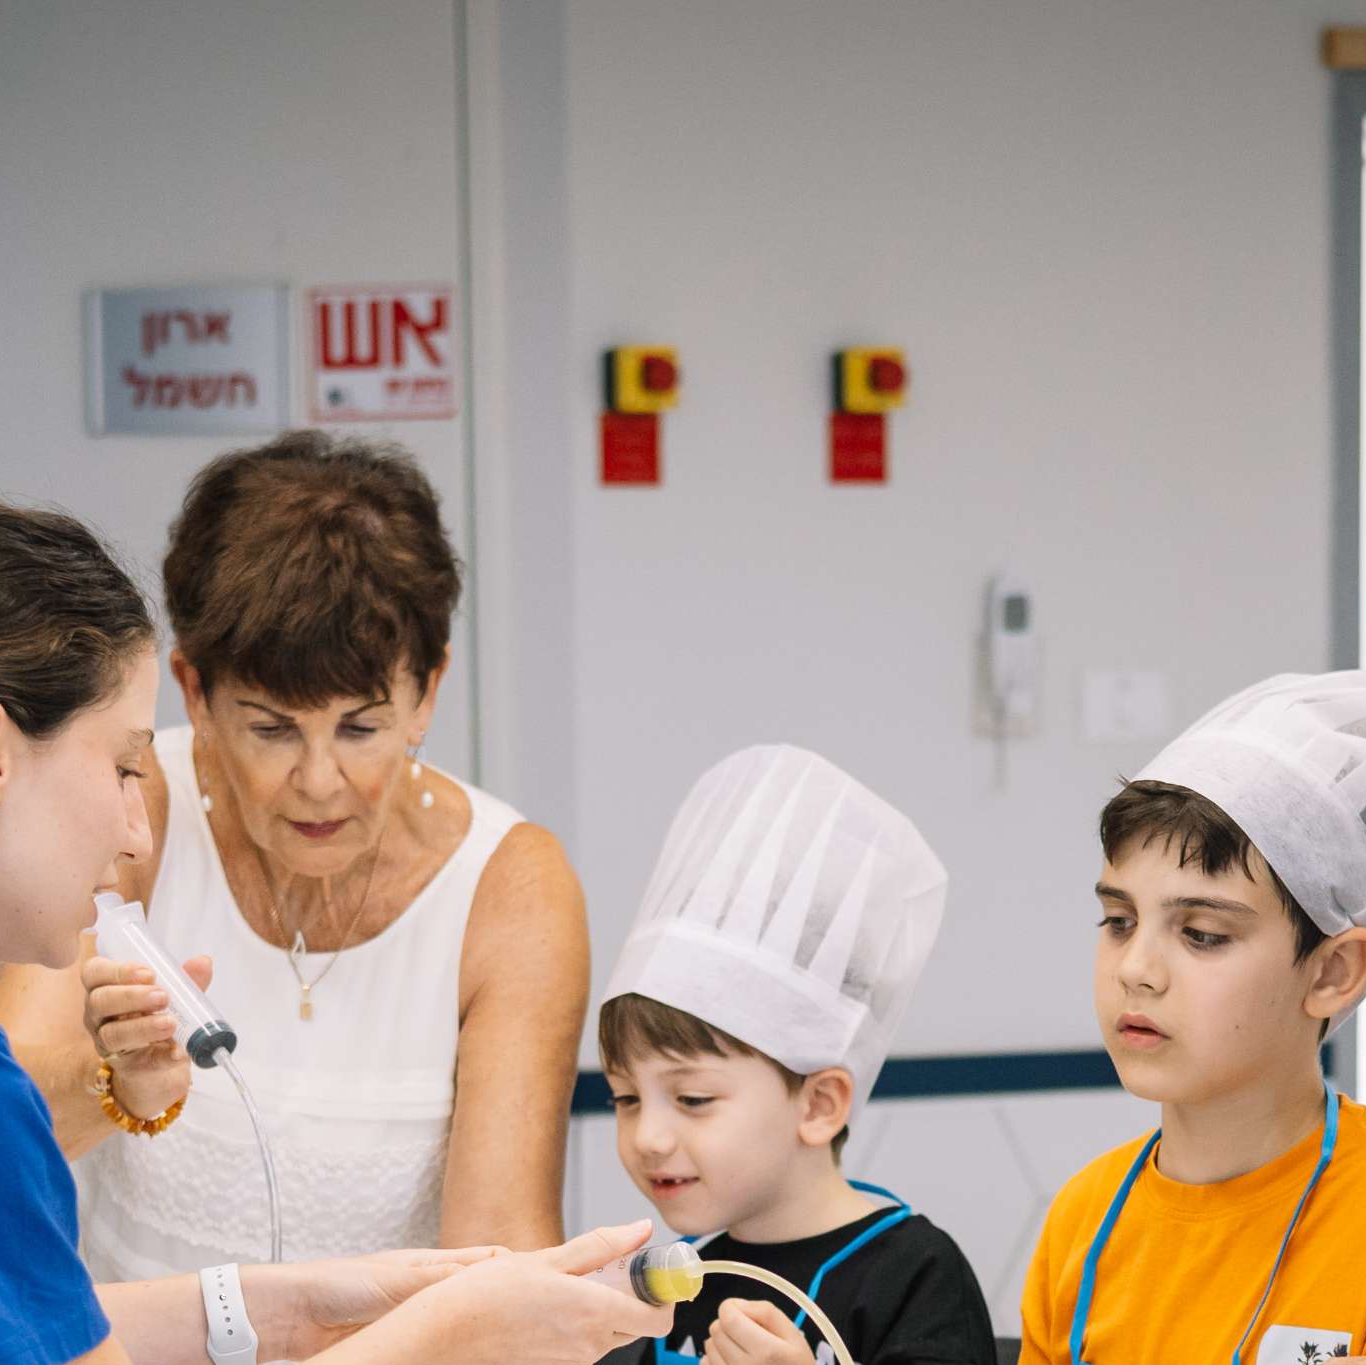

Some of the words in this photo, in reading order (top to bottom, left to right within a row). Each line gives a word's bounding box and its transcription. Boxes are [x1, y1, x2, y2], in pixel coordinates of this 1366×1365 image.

[140, 308, 232, 358] ארון
[317, 298, 449, 370] אש
[122, 366, 259, 410] חשמל
